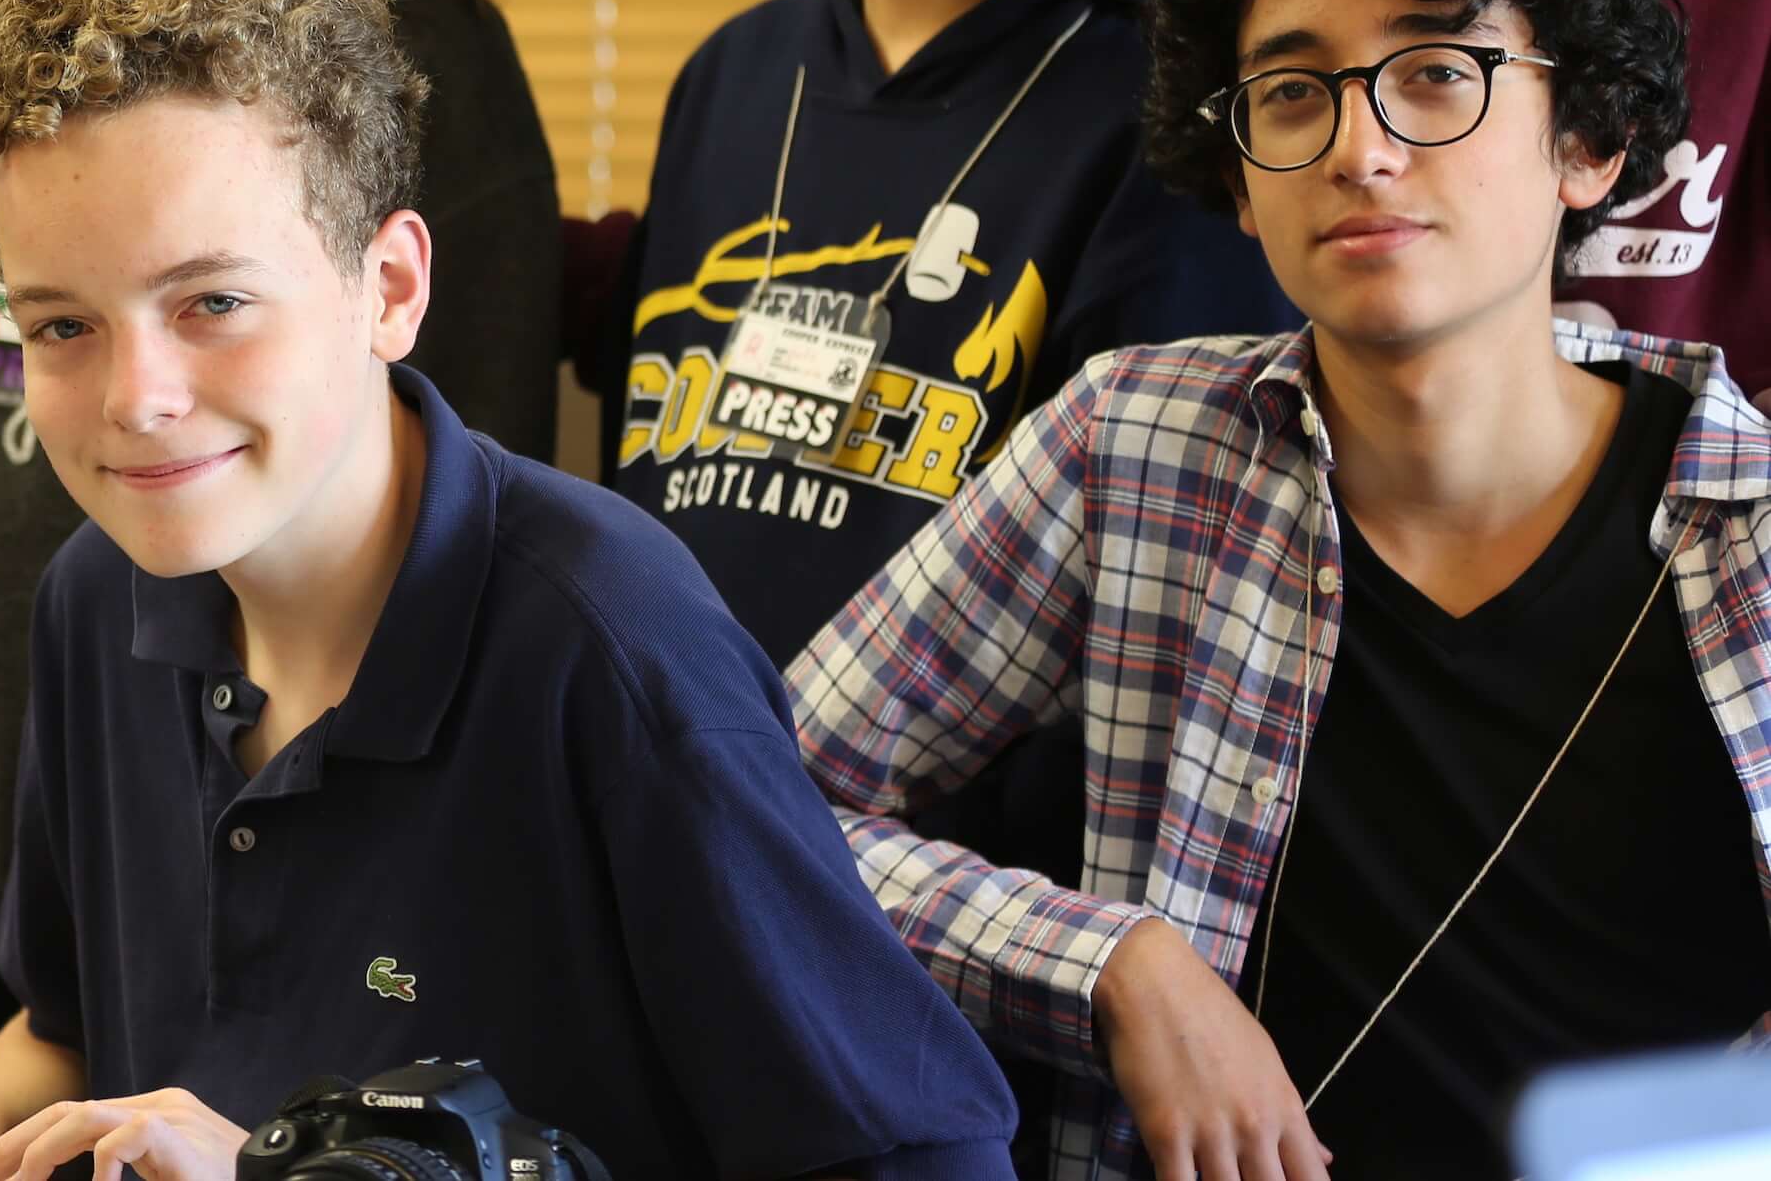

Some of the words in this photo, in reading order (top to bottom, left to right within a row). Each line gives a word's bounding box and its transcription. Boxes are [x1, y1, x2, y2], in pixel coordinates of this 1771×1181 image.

[1616, 238, 1662, 265] est.
[617, 345, 989, 506] COER
[717, 381, 839, 447] PRESS
[662, 463, 850, 530] SCOTLAND
[361, 1090, 425, 1110] Canon
[509, 1157, 540, 1172] EOS
